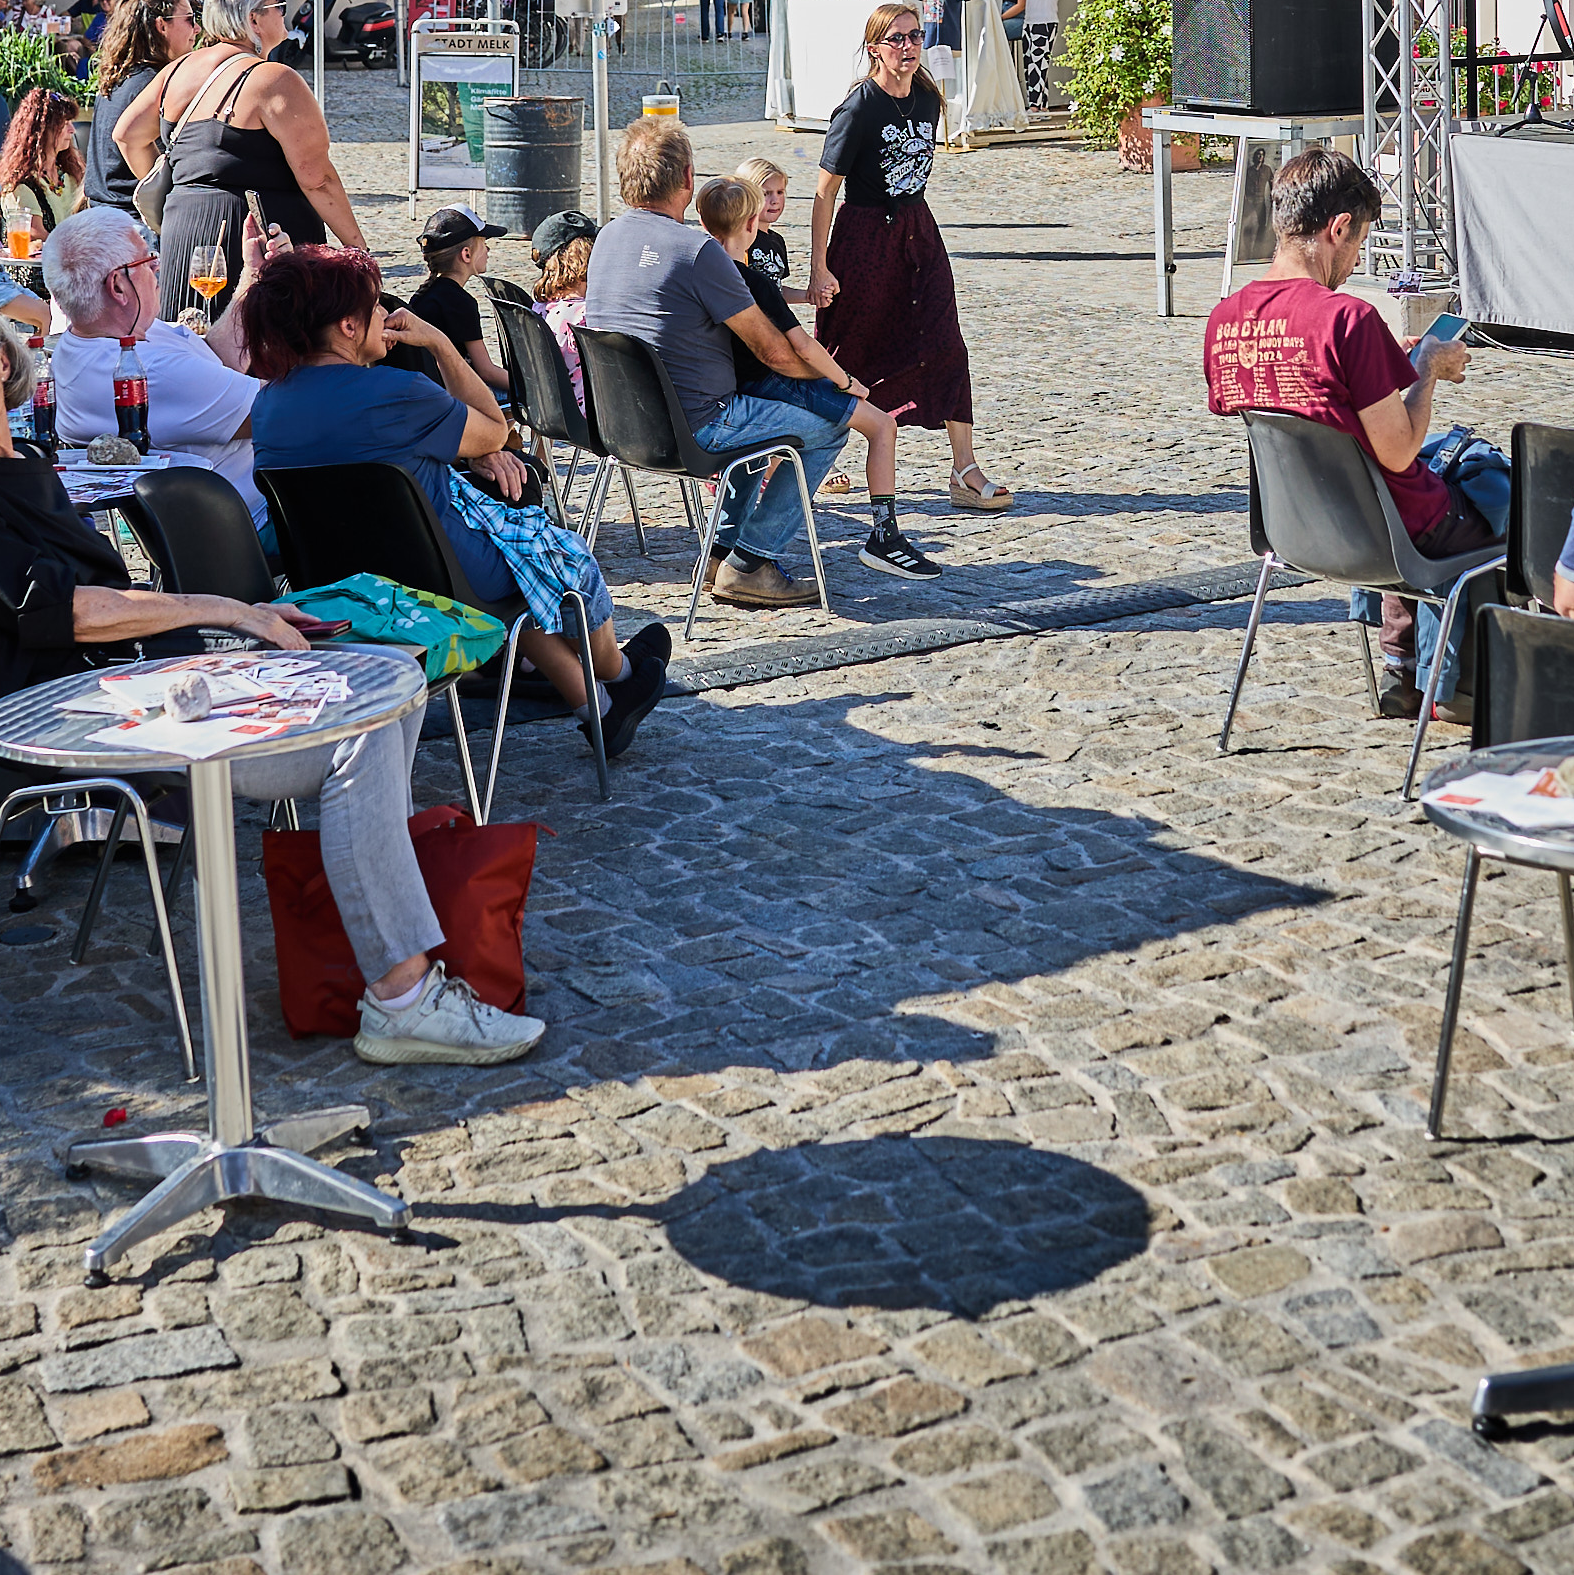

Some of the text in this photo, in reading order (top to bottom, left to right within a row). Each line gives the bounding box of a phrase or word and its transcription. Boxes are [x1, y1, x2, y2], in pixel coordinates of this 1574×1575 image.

[477, 39, 510, 49] MELK
[1216, 318, 1288, 341] BOB DYLAN
[1283, 336, 1305, 348] WAYS
[1257, 350, 1283, 361] 2024
